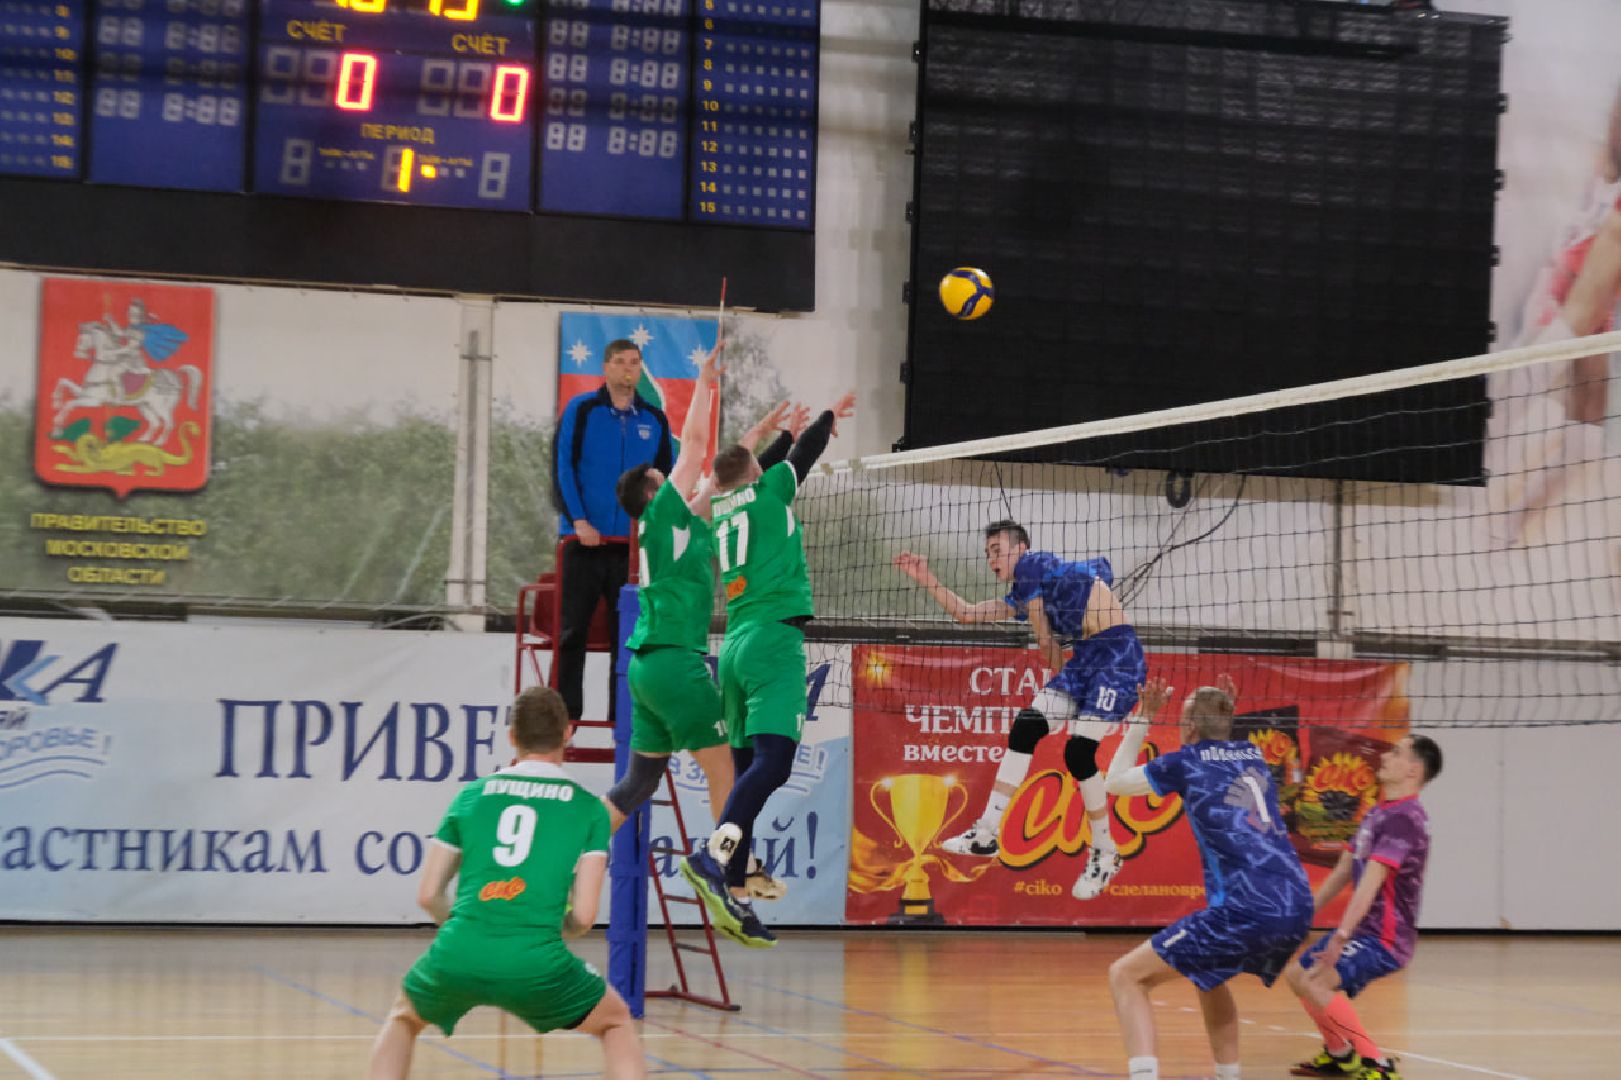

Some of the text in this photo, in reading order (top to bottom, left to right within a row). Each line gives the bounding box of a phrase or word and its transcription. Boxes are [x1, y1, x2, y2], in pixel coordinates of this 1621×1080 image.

[336, 52, 378, 111] 0
[489, 64, 531, 123] 0
[703, 100, 719, 111] 10
[360, 123, 436, 145] ПЕРИОД
[702, 121, 718, 132] 11
[701, 140, 718, 152] 12
[700, 161, 718, 173] 13
[700, 181, 717, 193] 14
[700, 201, 716, 213] 15
[30, 513, 208, 535] ПРАВИТЕЛЬСТВО
[716, 511, 749, 572] 17
[67, 566, 166, 584] ОБЛАСТИ
[1095, 686, 1117, 711] 10
[213, 699, 512, 782] ПРИВЕ
[903, 744, 1003, 763] вместе
[482, 780, 573, 802] ПУЩИНО
[1242, 776, 1271, 822] 1
[492, 805, 539, 867] 9
[0, 826, 327, 875] астникам
[1014, 878, 1063, 896] #ciko
